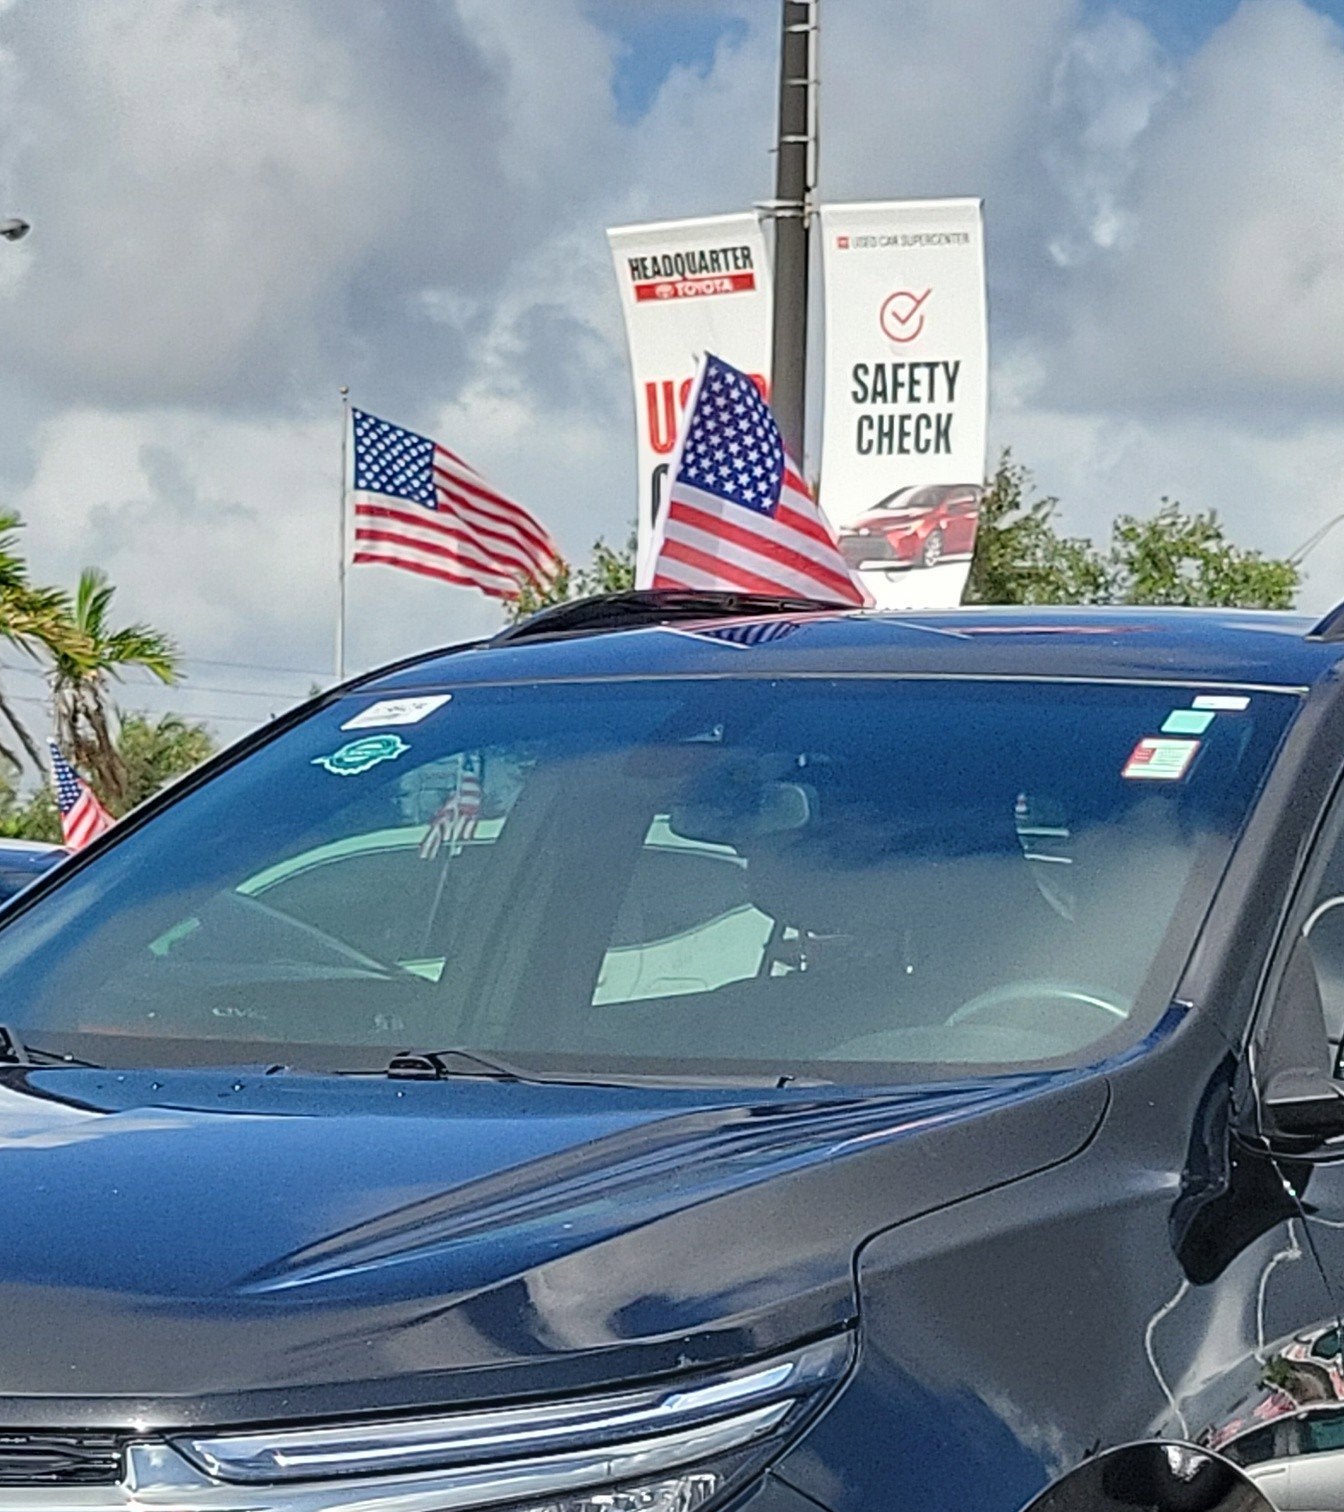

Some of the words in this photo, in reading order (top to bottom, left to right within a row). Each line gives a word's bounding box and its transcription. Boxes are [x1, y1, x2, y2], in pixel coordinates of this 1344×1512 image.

[628, 246, 754, 281] HEADQUARTER
[675, 277, 734, 297] TOYOTA
[851, 360, 961, 404] SAFETY
[856, 413, 953, 455] CHECK
